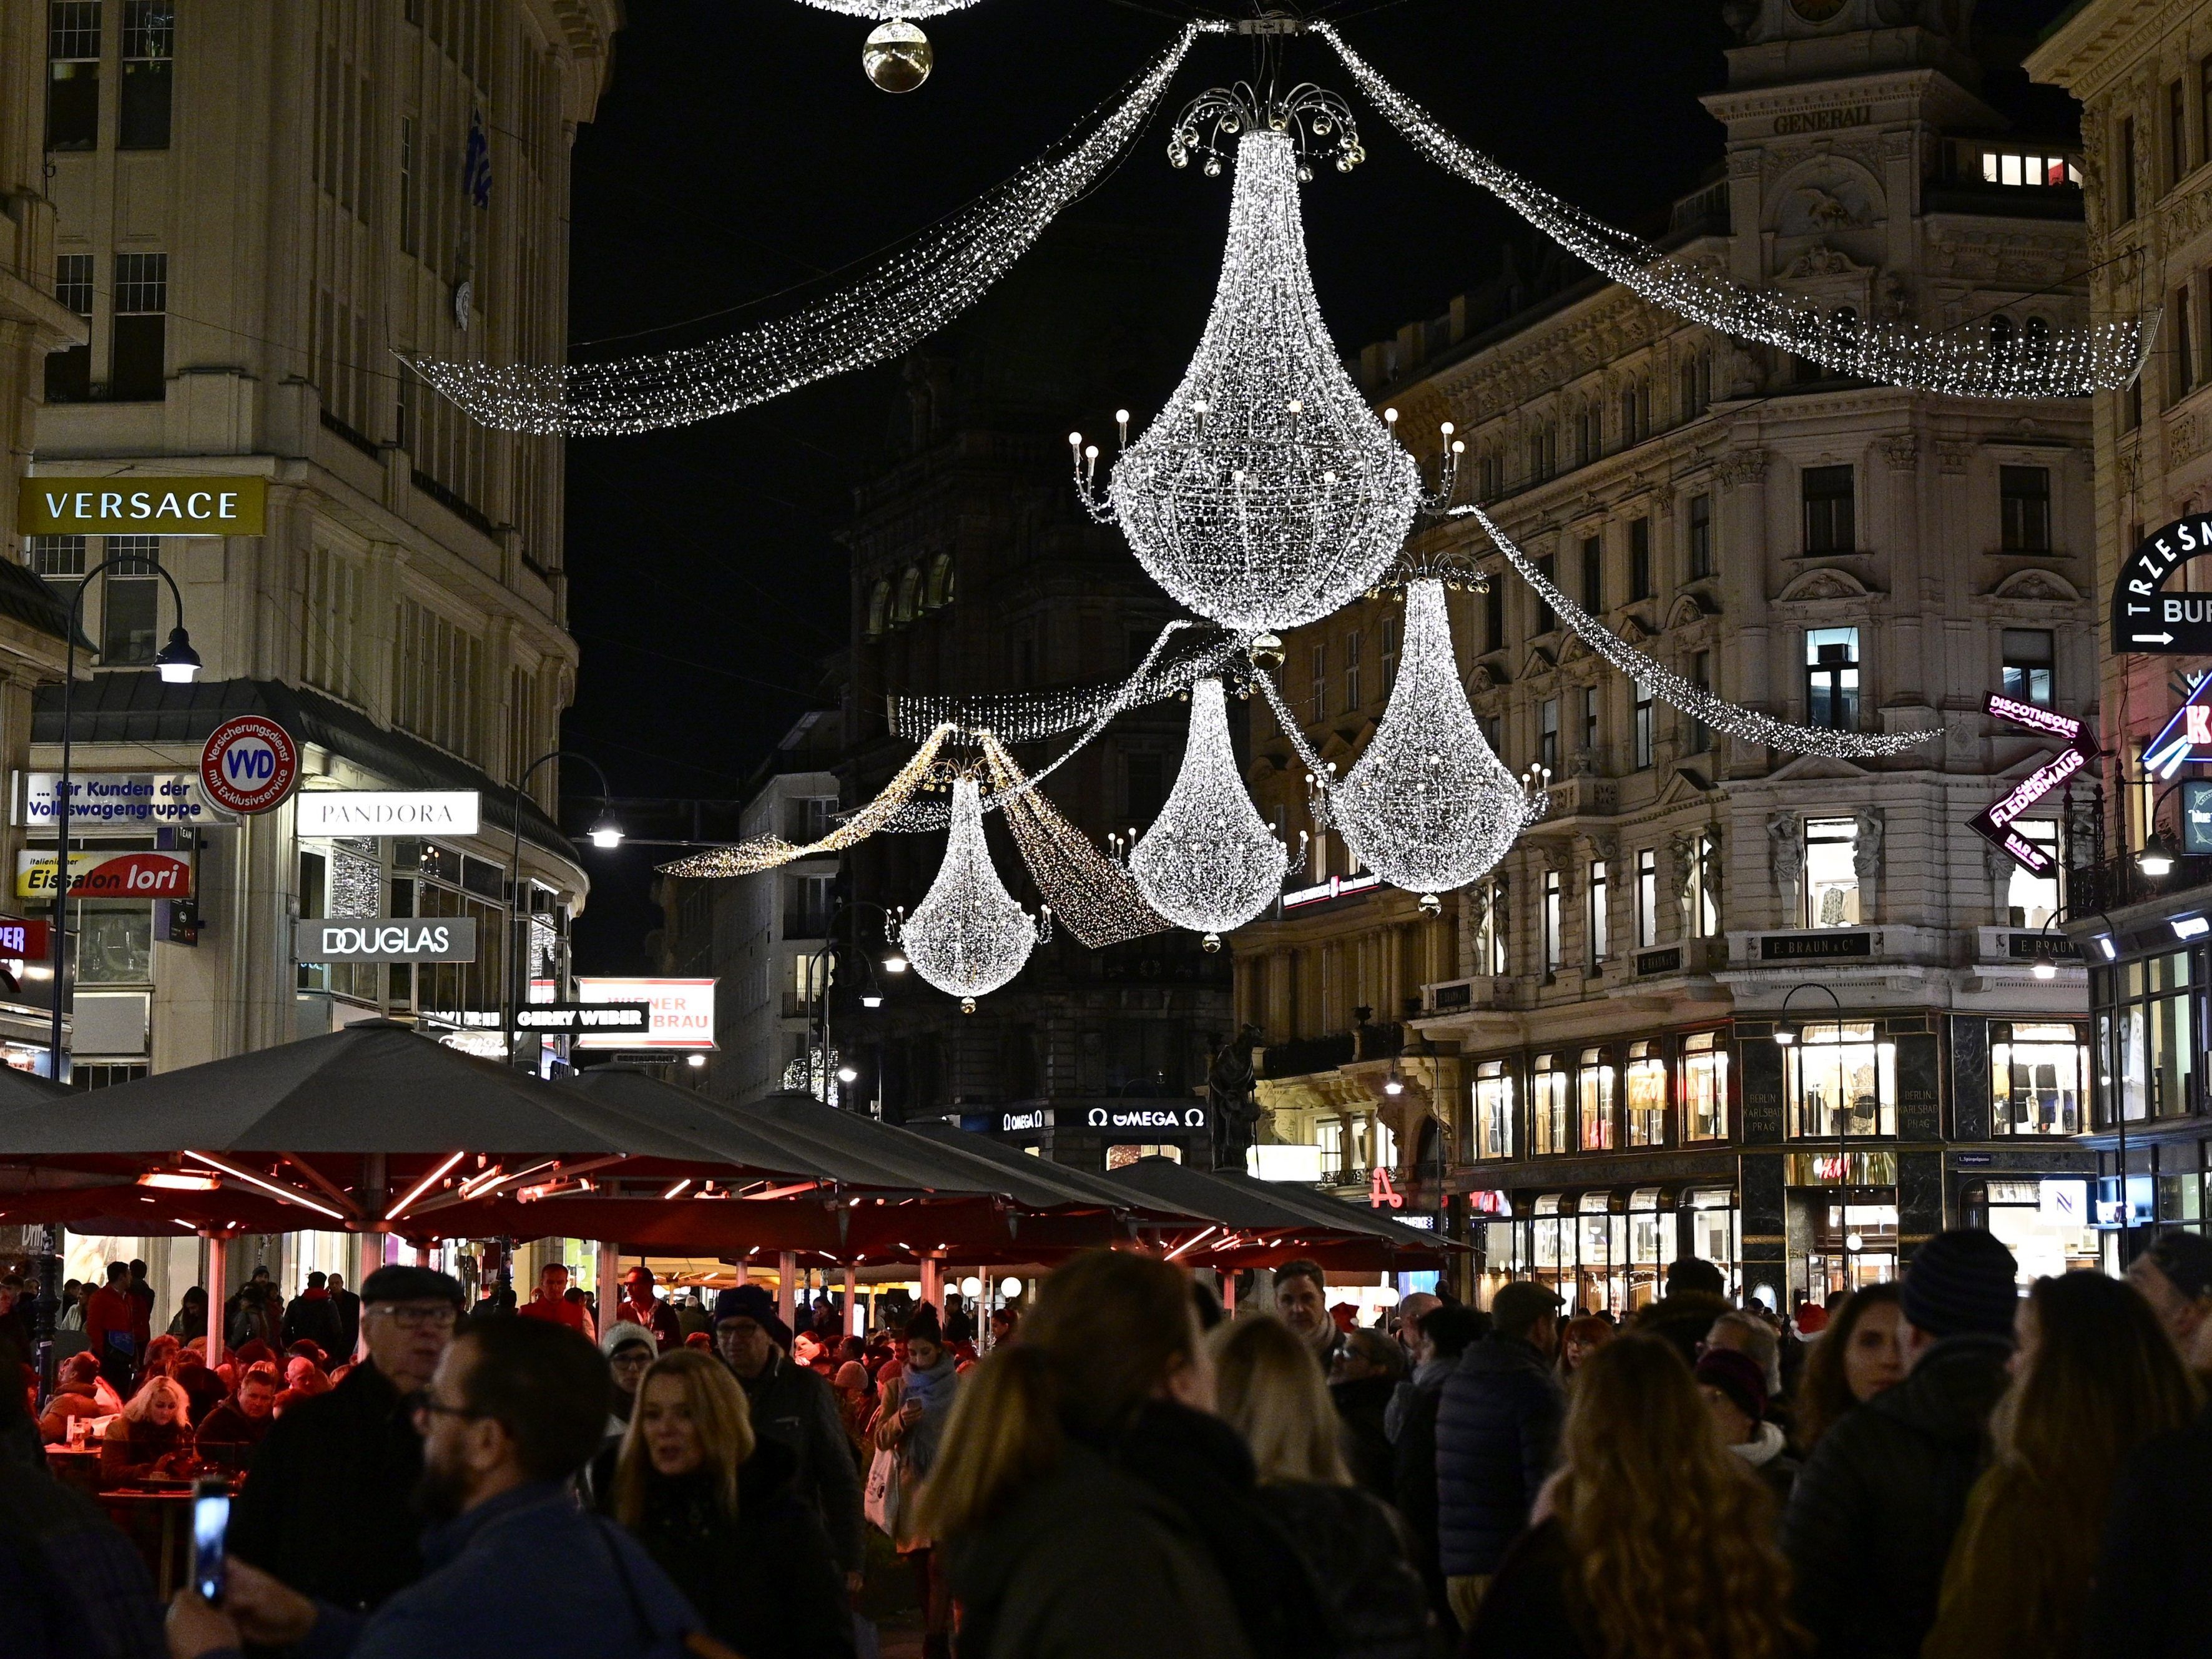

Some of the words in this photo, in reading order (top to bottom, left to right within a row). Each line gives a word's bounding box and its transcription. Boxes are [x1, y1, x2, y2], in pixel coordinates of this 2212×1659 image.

[1773, 105, 1873, 135] GENERALI
[45, 491, 238, 519] VERSACE
[1990, 696, 2080, 733] DISCOTHEQUE
[207, 724, 291, 762] Versicherungsdienst
[87, 781, 154, 797] Kunden
[160, 780, 190, 797] der
[209, 769, 223, 787] mit
[218, 769, 288, 806] Exklusivservice
[1990, 751, 2084, 829] FLEDERMAUS
[2015, 767, 2048, 795] CABARET
[322, 804, 453, 823] PANDORA
[2005, 832, 2031, 857] BAR
[27, 869, 121, 889] Eissalon
[322, 926, 450, 954] DOUGLAS
[1773, 942, 1784, 954] E.
[1788, 940, 1829, 953] BRAUN
[1833, 943, 1839, 952] &
[2021, 940, 2031, 952] E.
[517, 1010, 577, 1026] GERRY
[578, 1010, 642, 1026] WEBER
[1749, 1093, 1776, 1103] BERLIN
[1905, 1090, 1932, 1100] BERLIN
[1113, 1111, 1179, 1126] OMEGA
[1743, 1108, 1784, 1118] KARLSBAD
[1898, 1104, 1939, 1115] KARLSBAD
[1011, 1113, 1034, 1131] OMEGA
[1752, 1121, 1776, 1132] PRAG
[1907, 1119, 1930, 1129] PRAG
